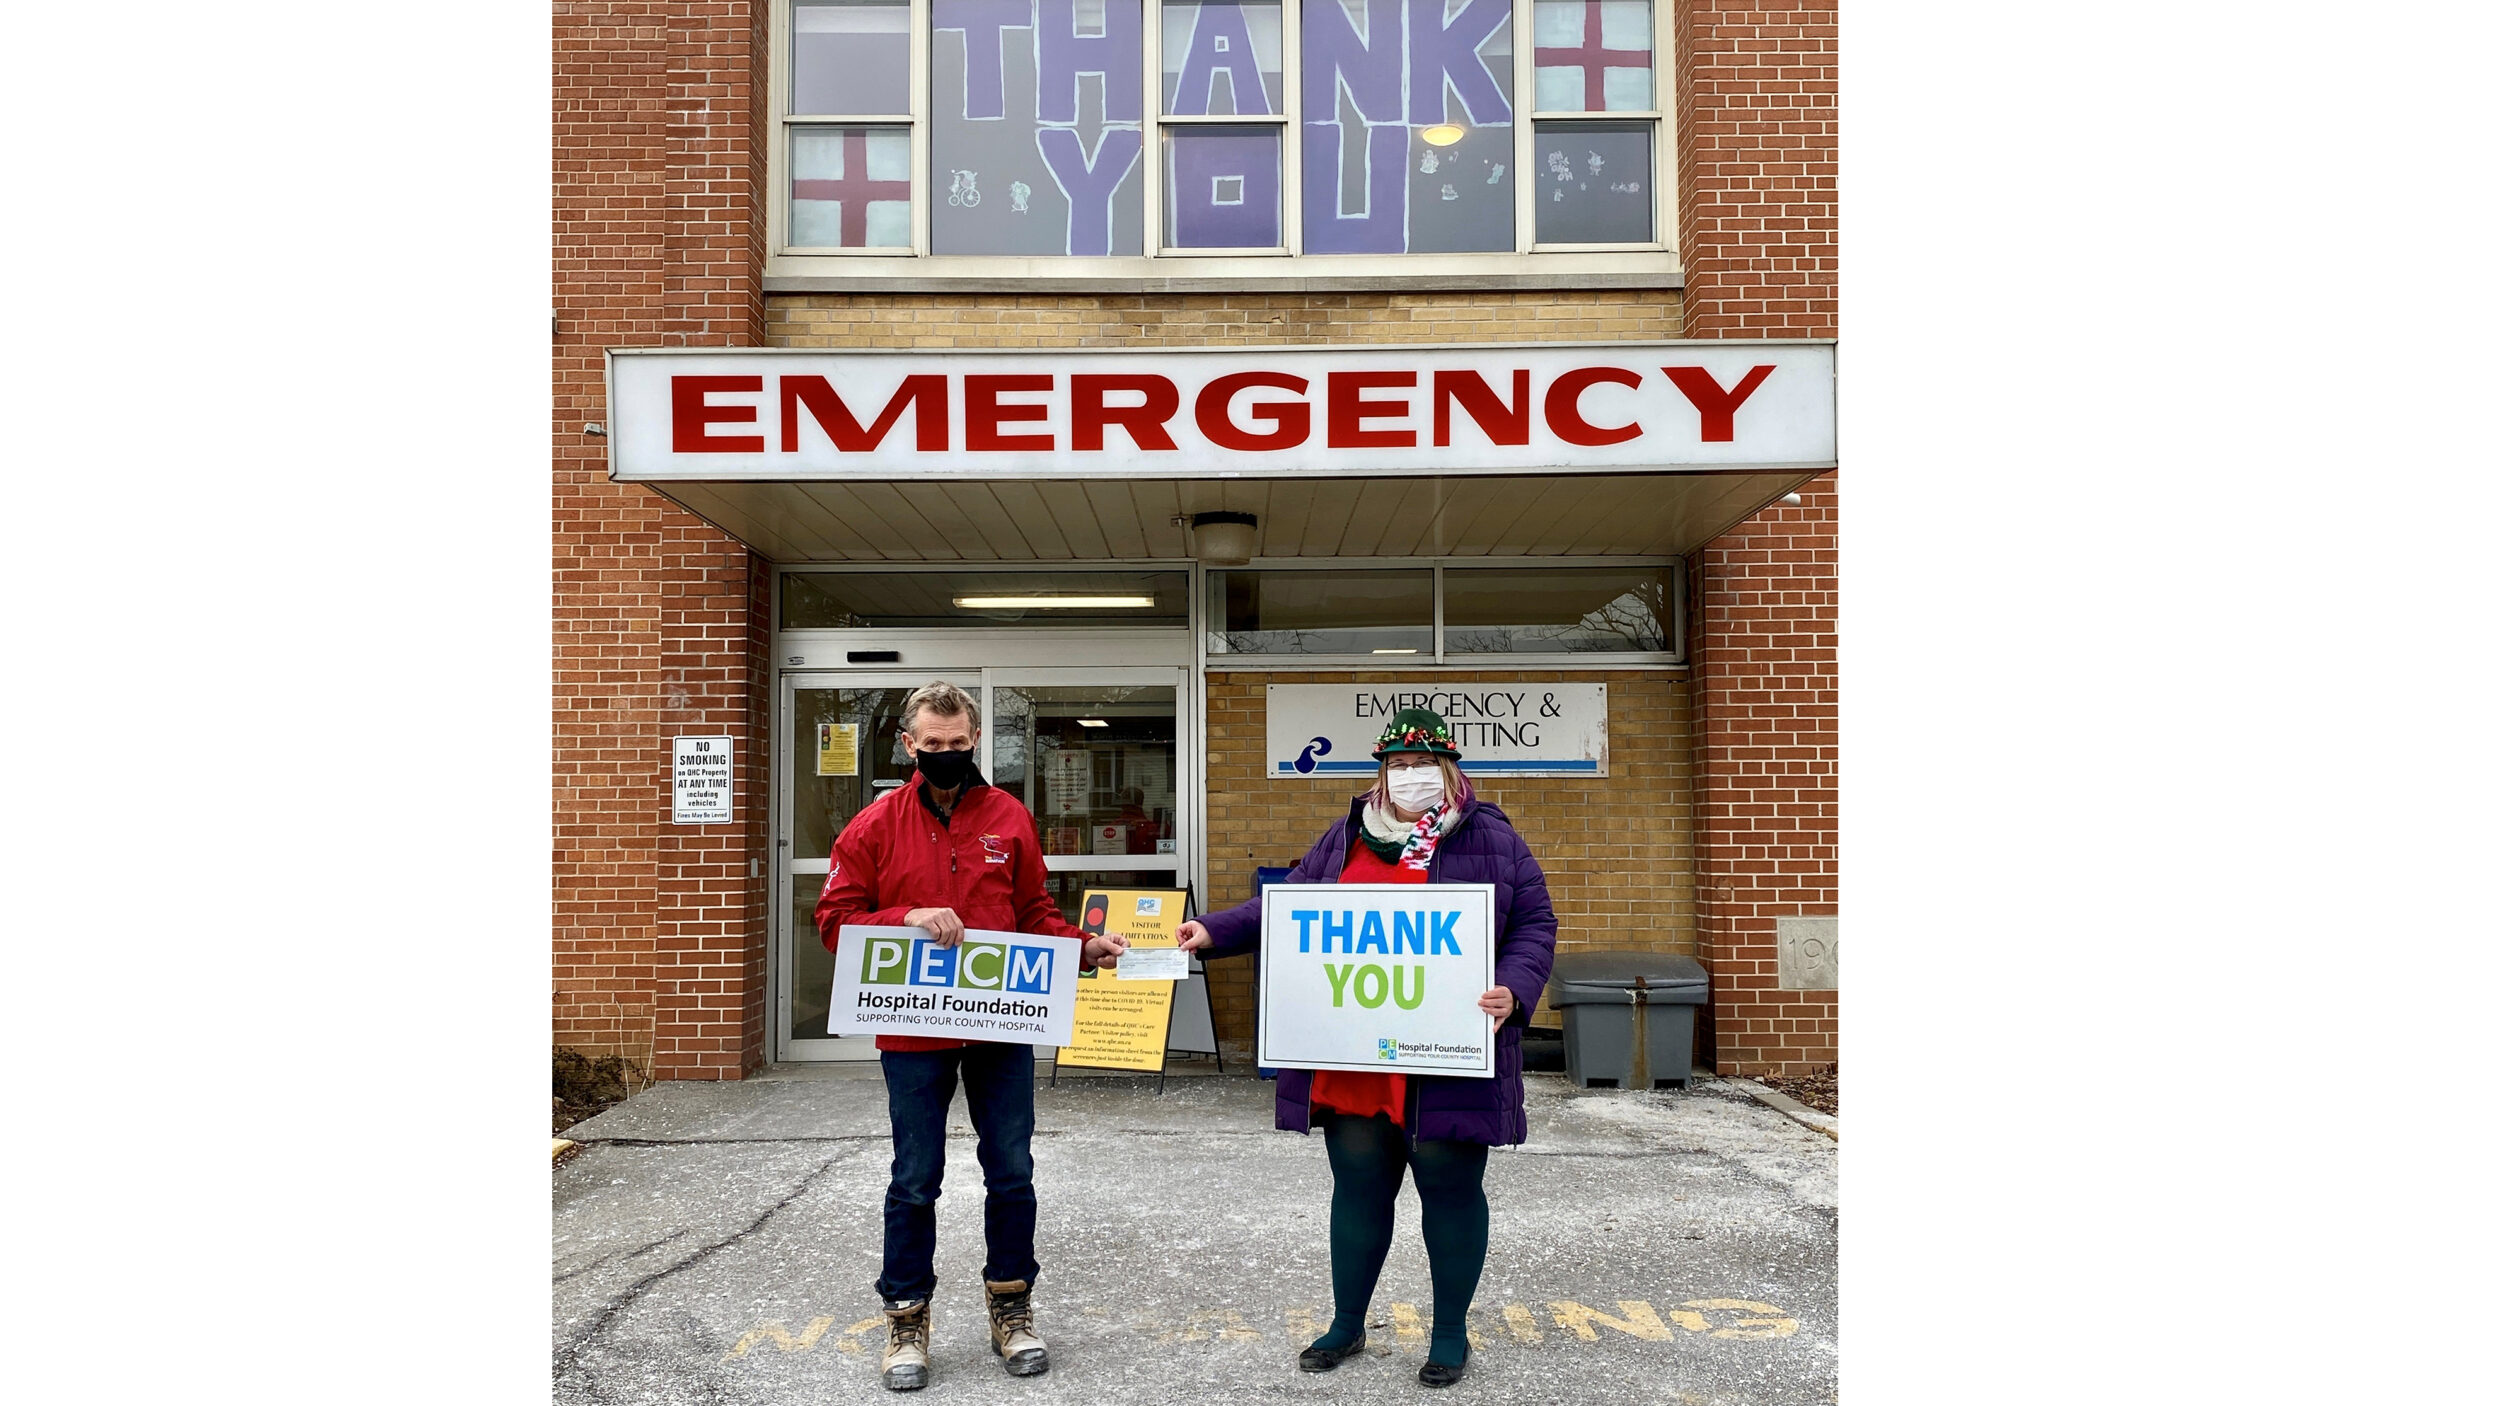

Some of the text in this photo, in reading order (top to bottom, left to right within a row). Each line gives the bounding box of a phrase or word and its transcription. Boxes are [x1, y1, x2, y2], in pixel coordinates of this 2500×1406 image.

[933, 0, 1513, 126] THANK
[1036, 122, 1408, 257] YOU
[671, 365, 1777, 453] EMERGENCY
[1355, 692, 1561, 717] EMERGENCY &
[696, 742, 710, 752] NO
[1383, 722, 1540, 747] ITTING
[680, 755, 726, 766] SMOKING
[702, 769, 728, 777] Property
[678, 778, 727, 788] AT ANY TIME
[687, 791, 718, 799] including
[1291, 910, 1463, 956] THANK
[868, 941, 1051, 992] PECM
[1323, 964, 1425, 1010] YOU
[857, 992, 1049, 1018] Hospital Foundation
[856, 1013, 1046, 1033] SUPPORTING YOUR COUNTY HOSPITAL
[1398, 1042, 1482, 1054] Hospital Foundation
